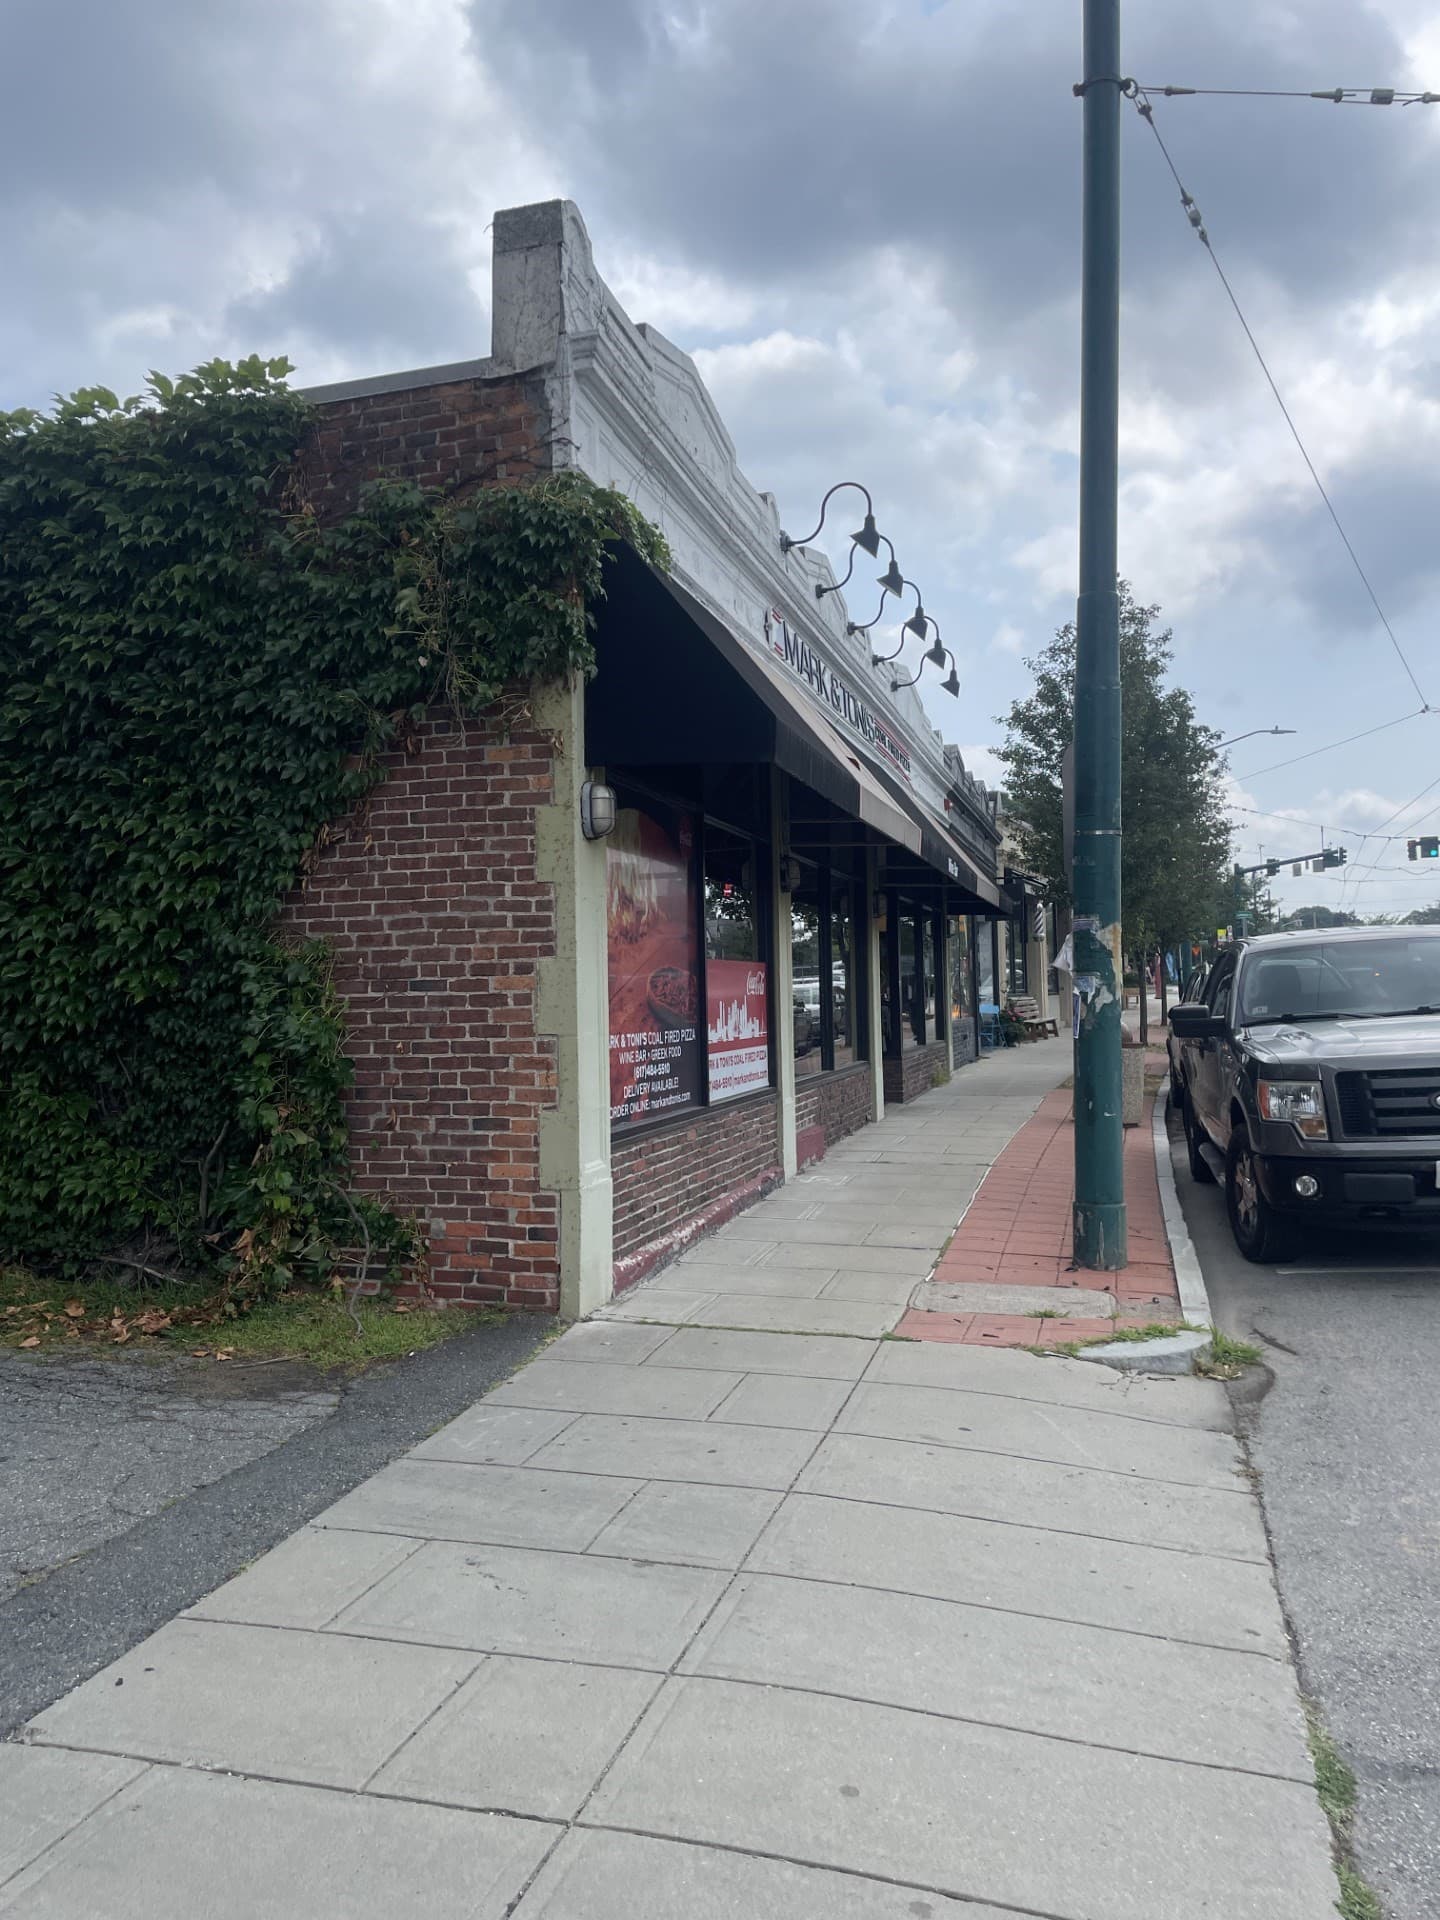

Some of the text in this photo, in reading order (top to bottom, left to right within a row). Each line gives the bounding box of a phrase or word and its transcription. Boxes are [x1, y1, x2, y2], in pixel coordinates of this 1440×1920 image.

[783, 621, 830, 702] MARK
[831, 673, 842, 712] &
[620, 1034, 626, 1048] &
[648, 1031, 663, 1045] COAL
[664, 1030, 680, 1044] FIRED
[681, 1028, 696, 1042] PIZZA
[619, 1046, 682, 1064] WINE BAR GREEK FOOD
[624, 1082, 651, 1098] DELIVERY
[610, 1104, 628, 1119] ORDER
